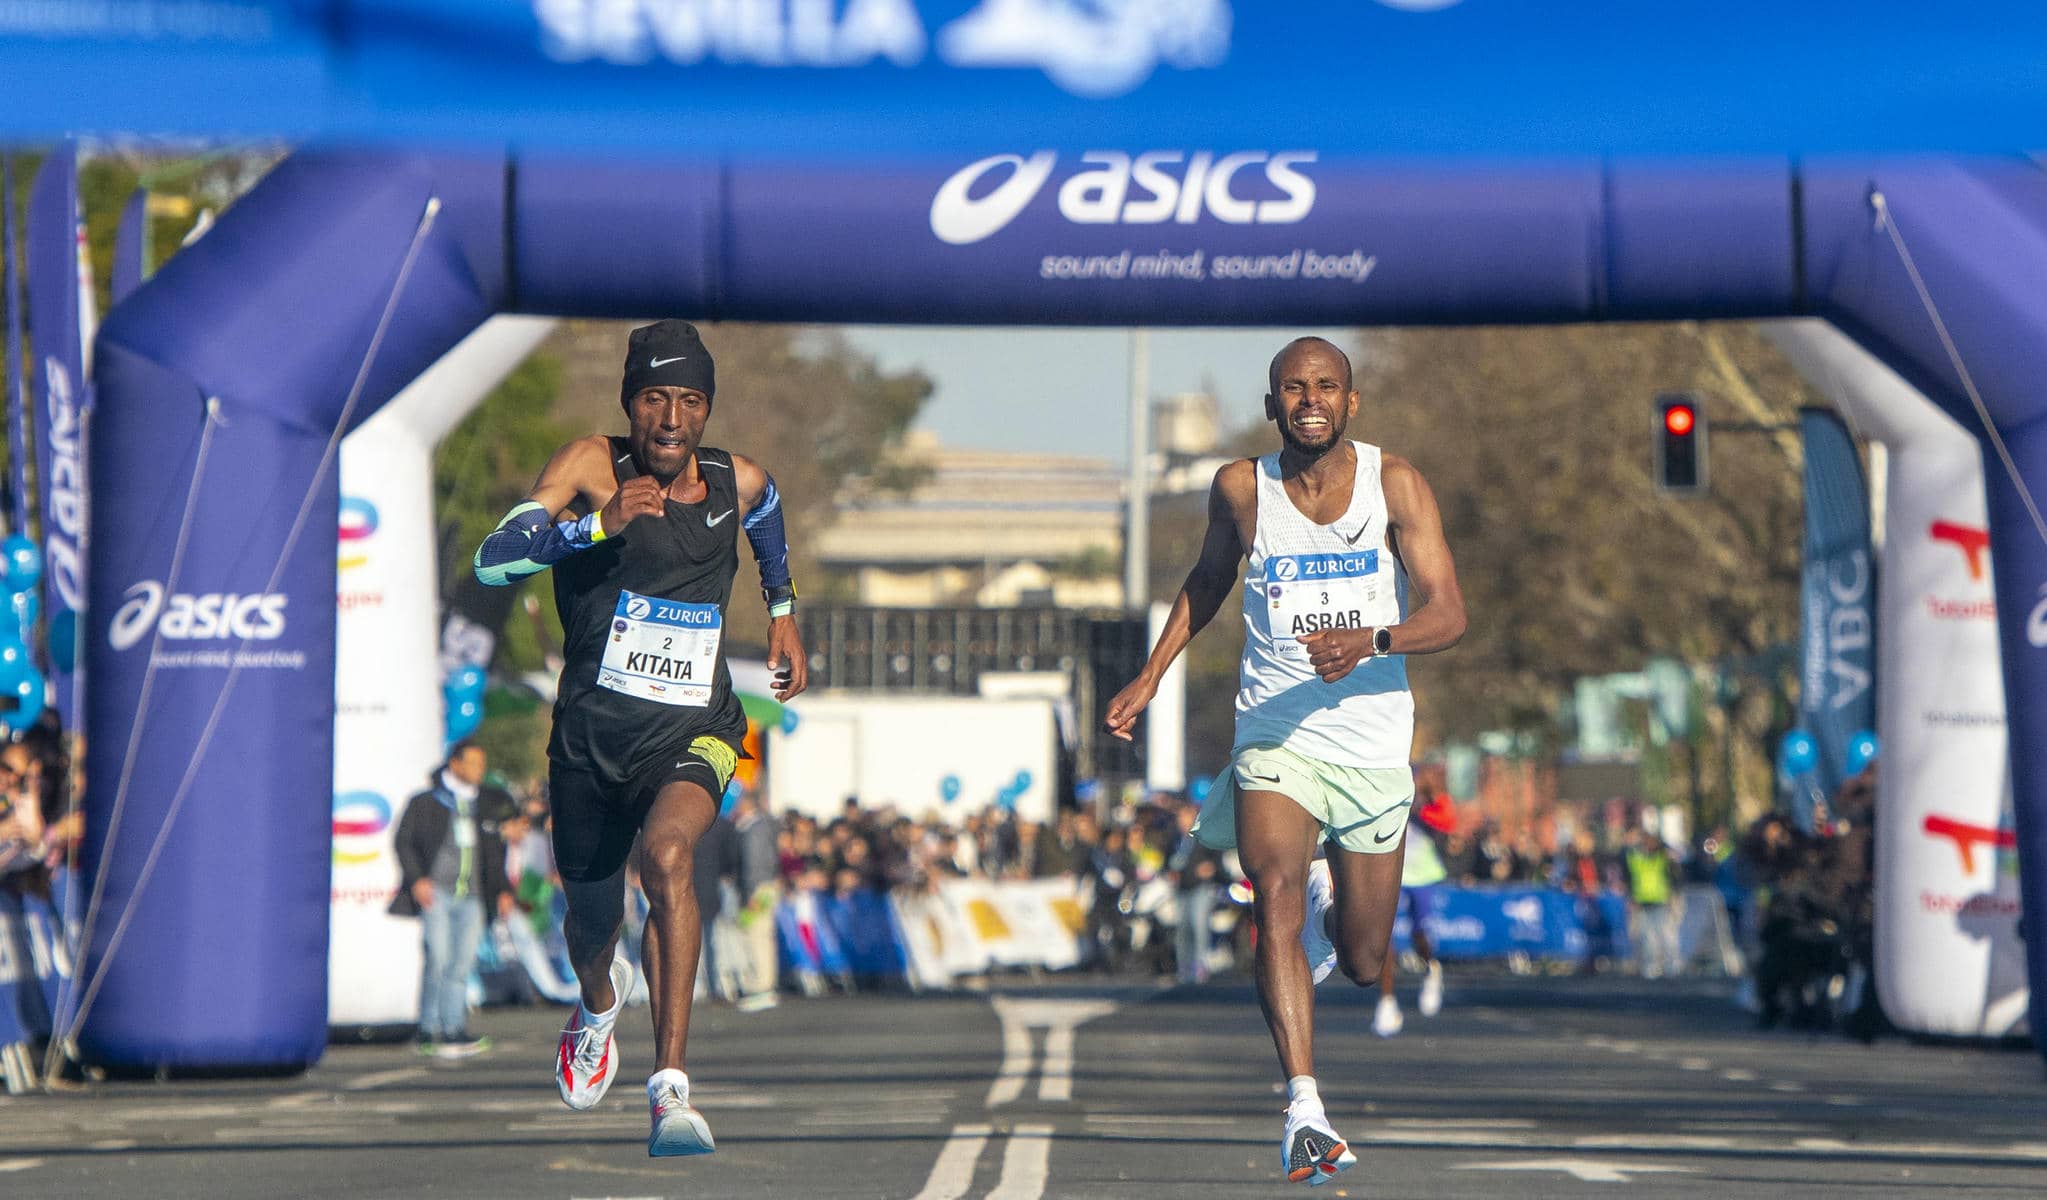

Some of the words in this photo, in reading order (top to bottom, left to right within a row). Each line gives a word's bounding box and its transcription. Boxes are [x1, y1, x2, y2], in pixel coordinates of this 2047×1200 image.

[1040, 251, 1128, 279] sound
[1130, 249, 1206, 281] mind,
[1211, 249, 1298, 279] sound
[1302, 249, 1376, 284] body
[1305, 558, 1366, 575] ZURICH
[1321, 592, 1329, 605] 3
[656, 606, 712, 623] ZURICH
[663, 637, 673, 650] 2
[626, 651, 692, 680] KITATA
